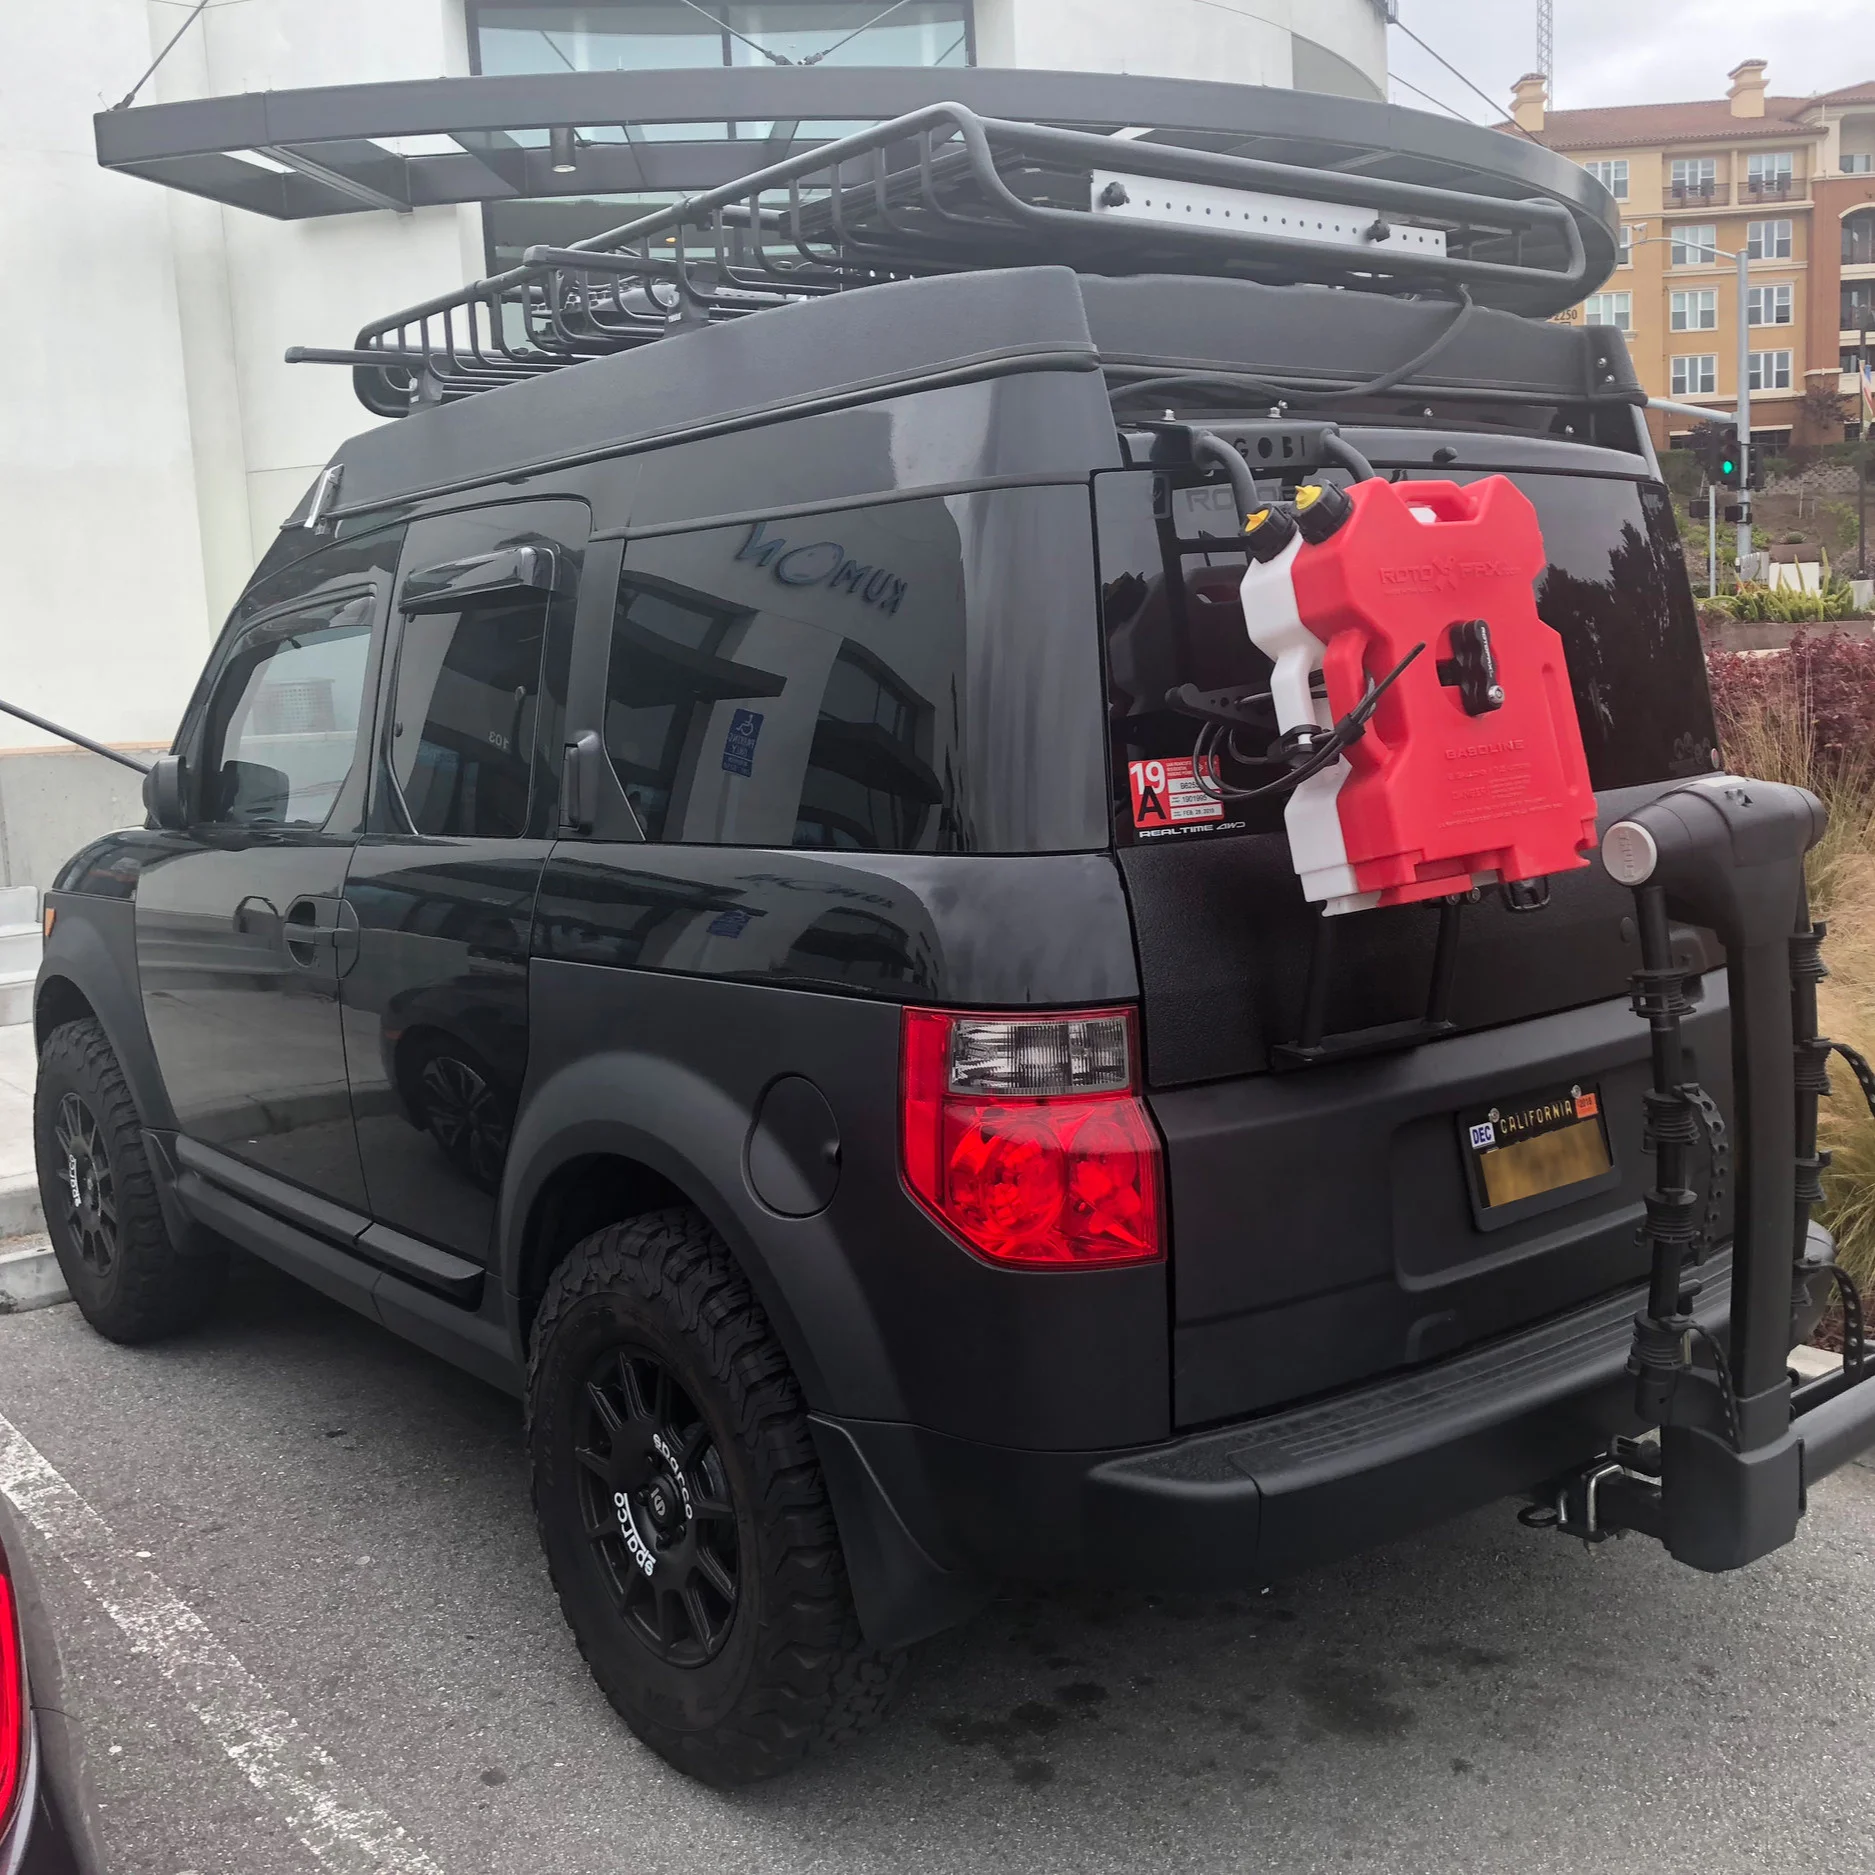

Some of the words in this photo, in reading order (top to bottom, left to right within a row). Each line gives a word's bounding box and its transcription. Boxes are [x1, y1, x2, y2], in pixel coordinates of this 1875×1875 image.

[1233, 435, 1305, 458] GOBI
[1445, 739, 1525, 760] GASOLINE
[1129, 761, 1166, 795] 19
[1137, 785, 1167, 822] A
[1139, 824, 1214, 838] REALTIME
[1216, 821, 1246, 830] AWD
[1500, 1100, 1573, 1134] CALIFORNIA
[1472, 1125, 1492, 1144] DEC
[653, 1434, 693, 1520] sparco
[614, 1492, 657, 1576] sparco
